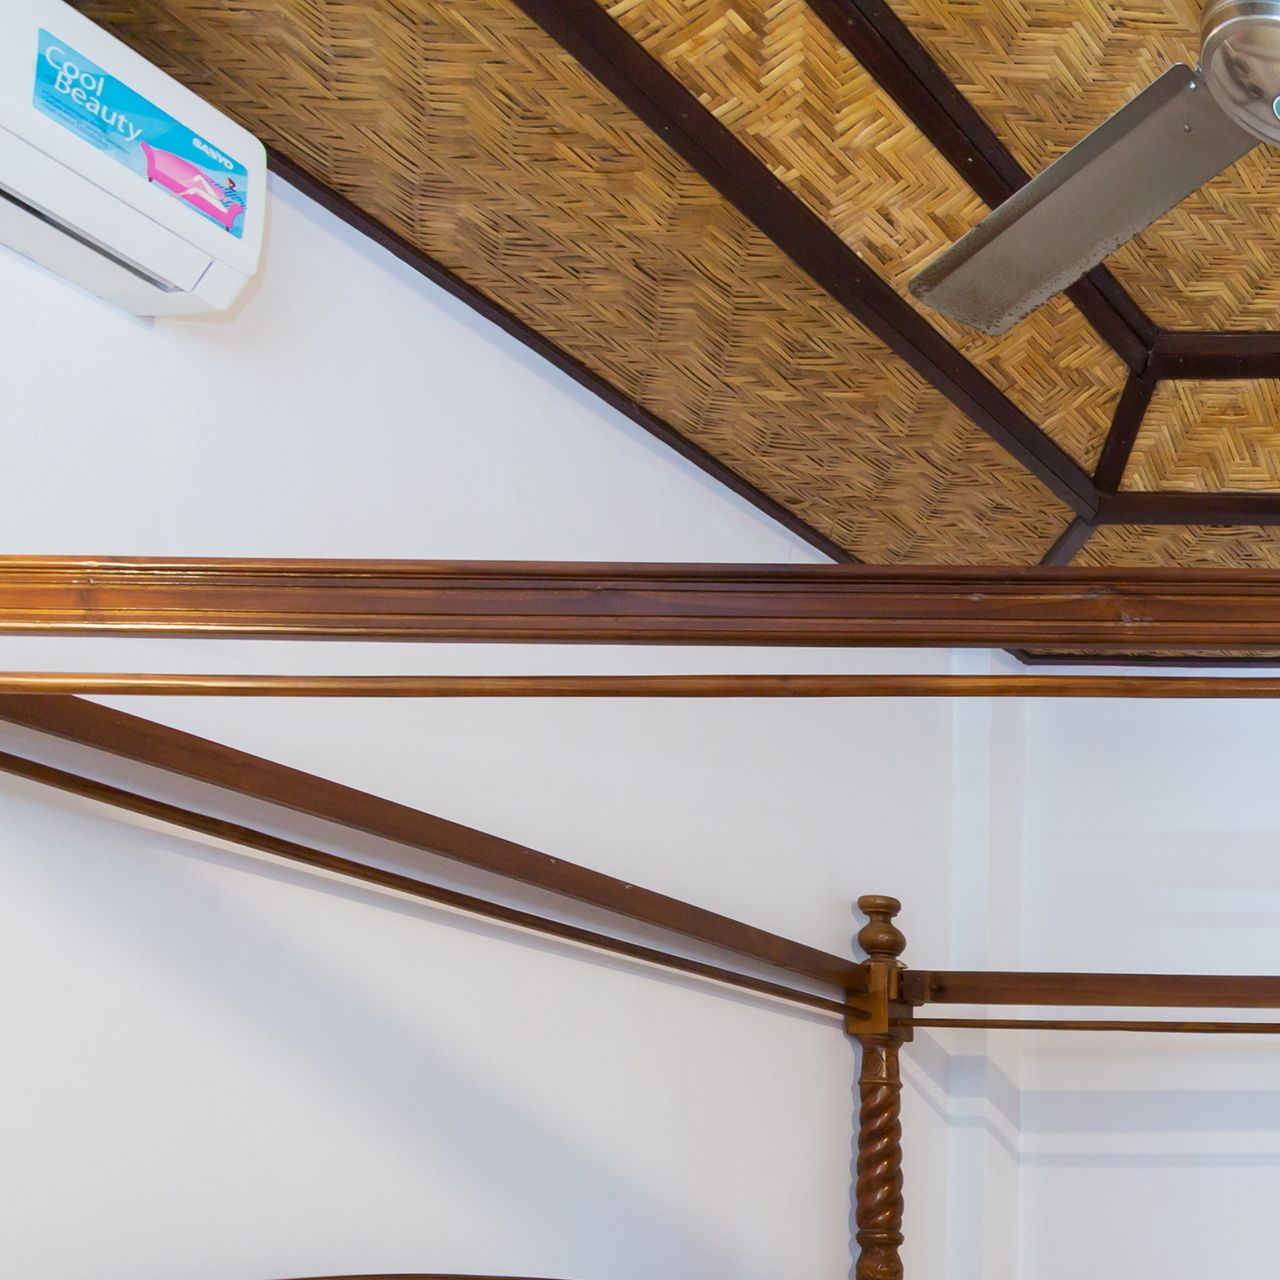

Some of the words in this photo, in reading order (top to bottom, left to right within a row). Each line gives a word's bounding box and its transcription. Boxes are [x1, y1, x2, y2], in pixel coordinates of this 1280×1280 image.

[46, 46, 105, 96] Cool
[54, 71, 143, 142] Beauty
[192, 137, 234, 170] SANYO
